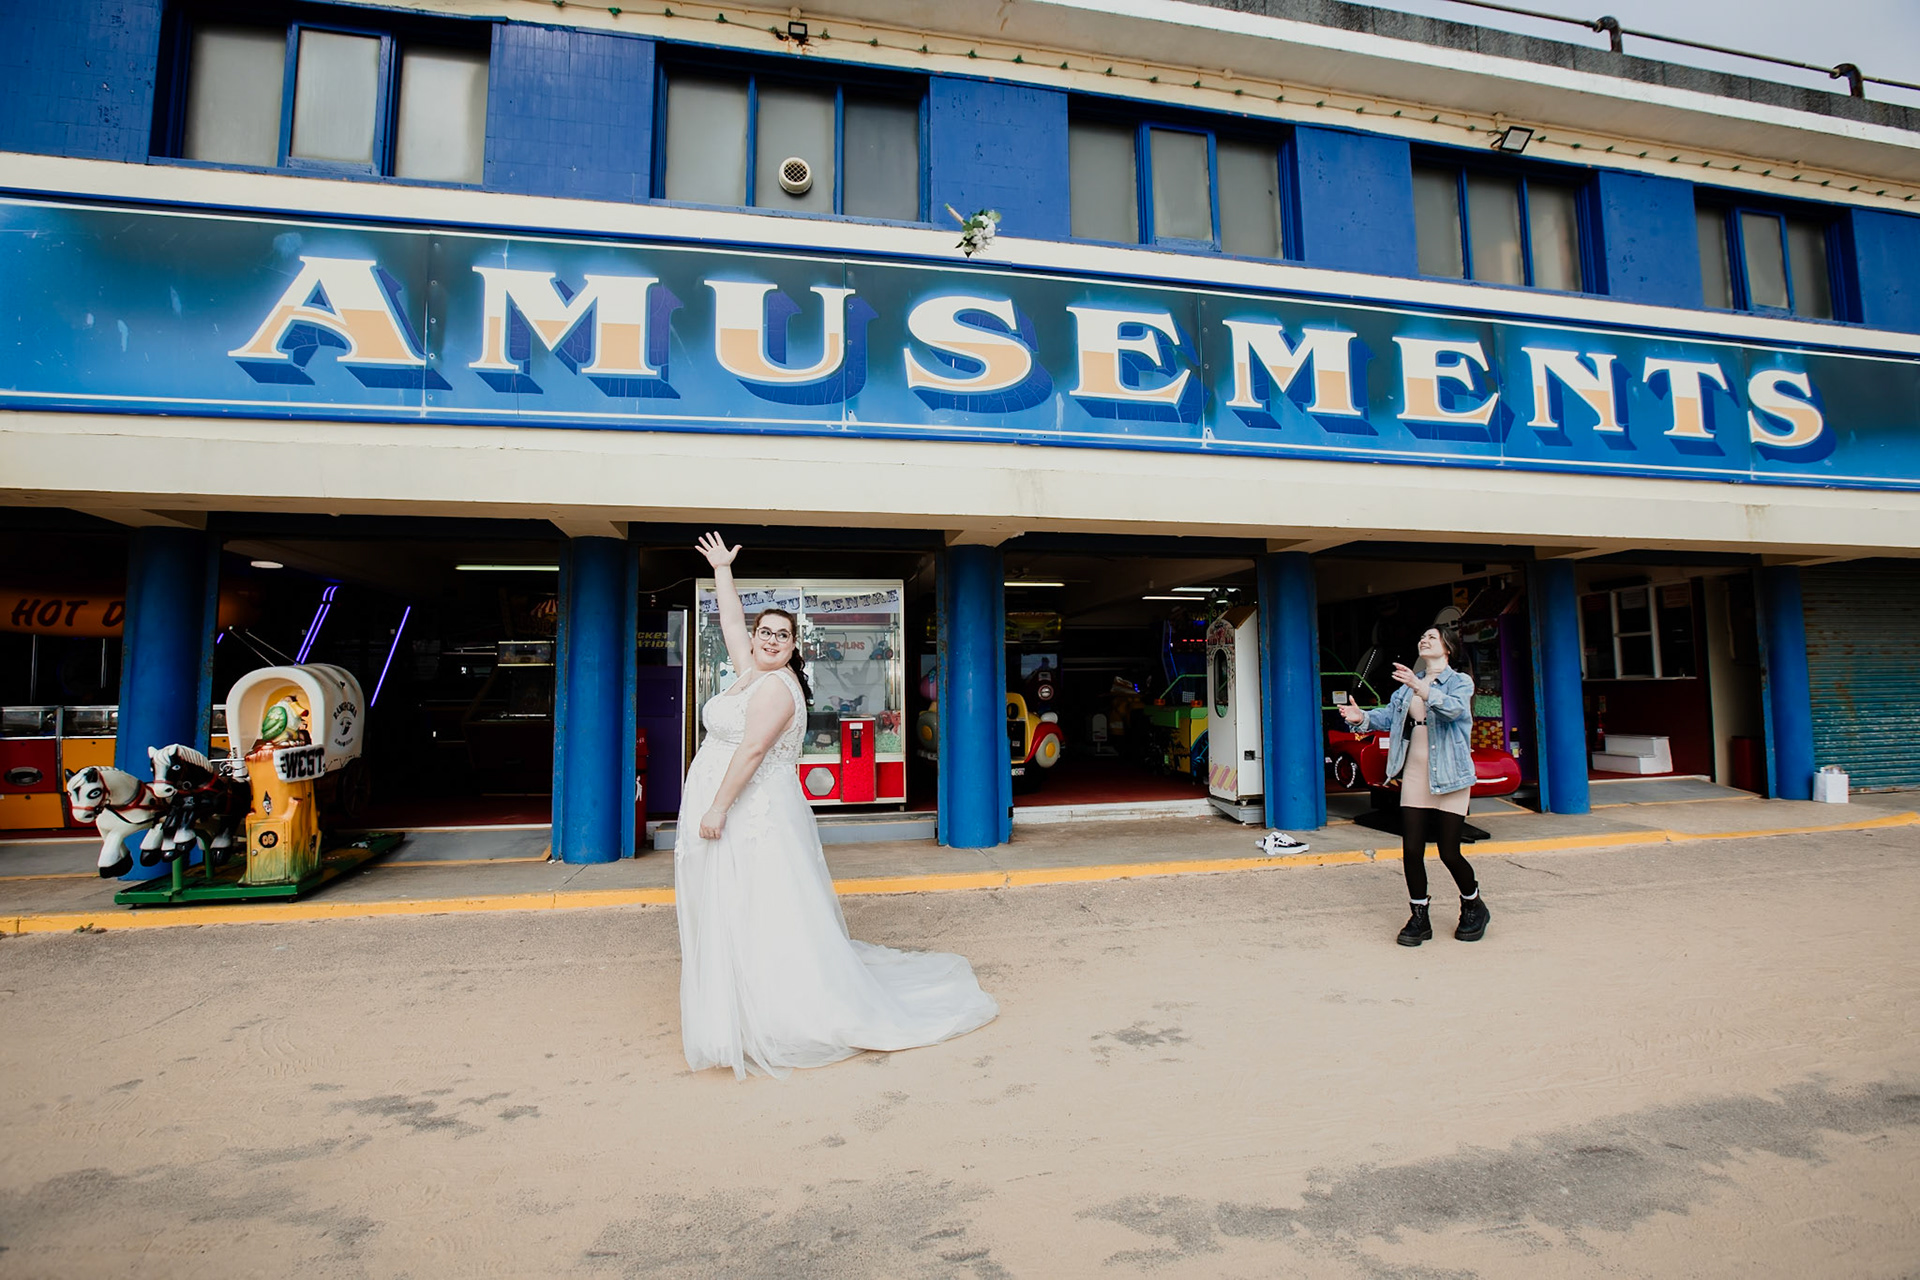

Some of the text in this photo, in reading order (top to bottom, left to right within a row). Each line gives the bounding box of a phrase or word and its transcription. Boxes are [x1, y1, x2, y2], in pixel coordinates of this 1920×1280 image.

[228, 255, 1827, 451] AMUSEMENTS
[11, 599, 89, 626] HOT
[699, 588, 899, 613] FILY FUN CENTRE
[285, 747, 325, 778] WEST
